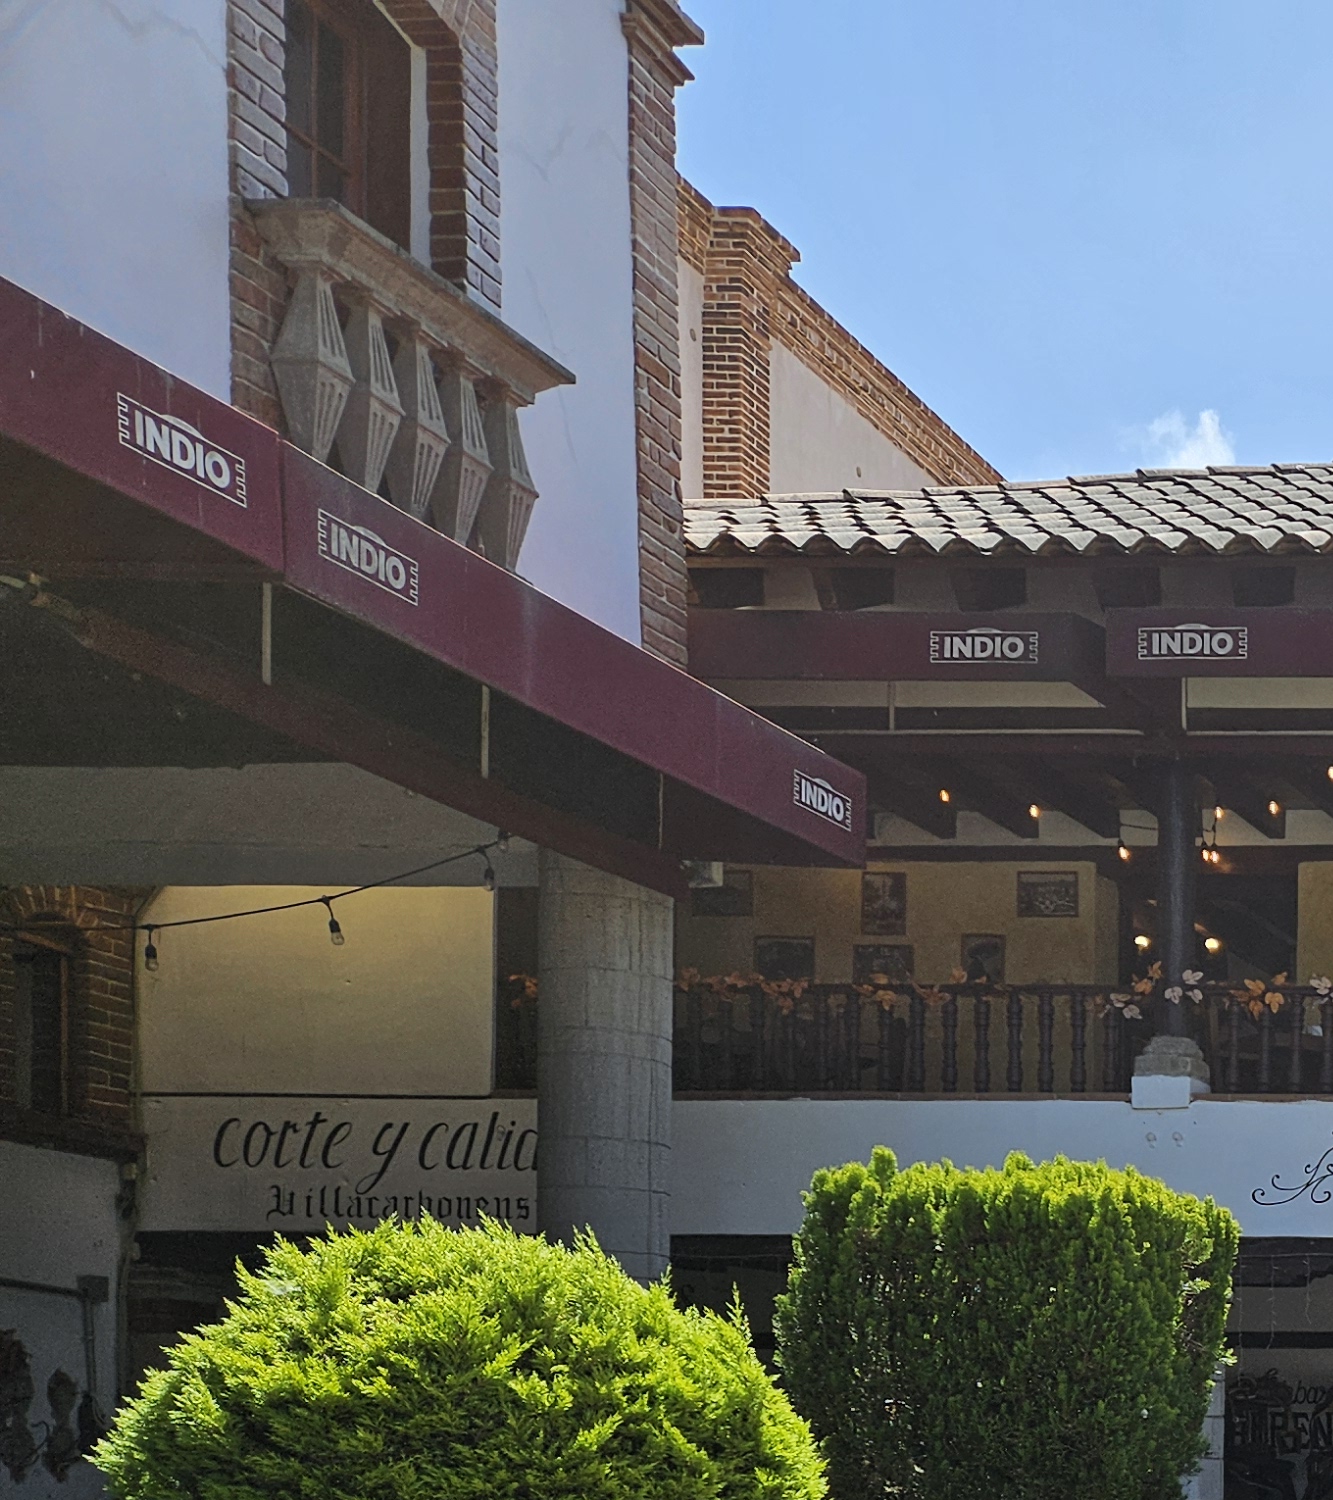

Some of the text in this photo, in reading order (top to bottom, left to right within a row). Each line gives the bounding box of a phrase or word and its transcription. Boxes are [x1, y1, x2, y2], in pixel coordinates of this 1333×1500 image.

[135, 410, 230, 488] INDIO
[330, 522, 406, 589] INDIO
[943, 636, 1024, 659] INDIO
[1152, 632, 1233, 655] INDIO
[801, 778, 844, 821] INDIO
[213, 1111, 352, 1169] corte
[355, 1122, 411, 1195] y
[266, 1184, 538, 1221] Villacarbonens
